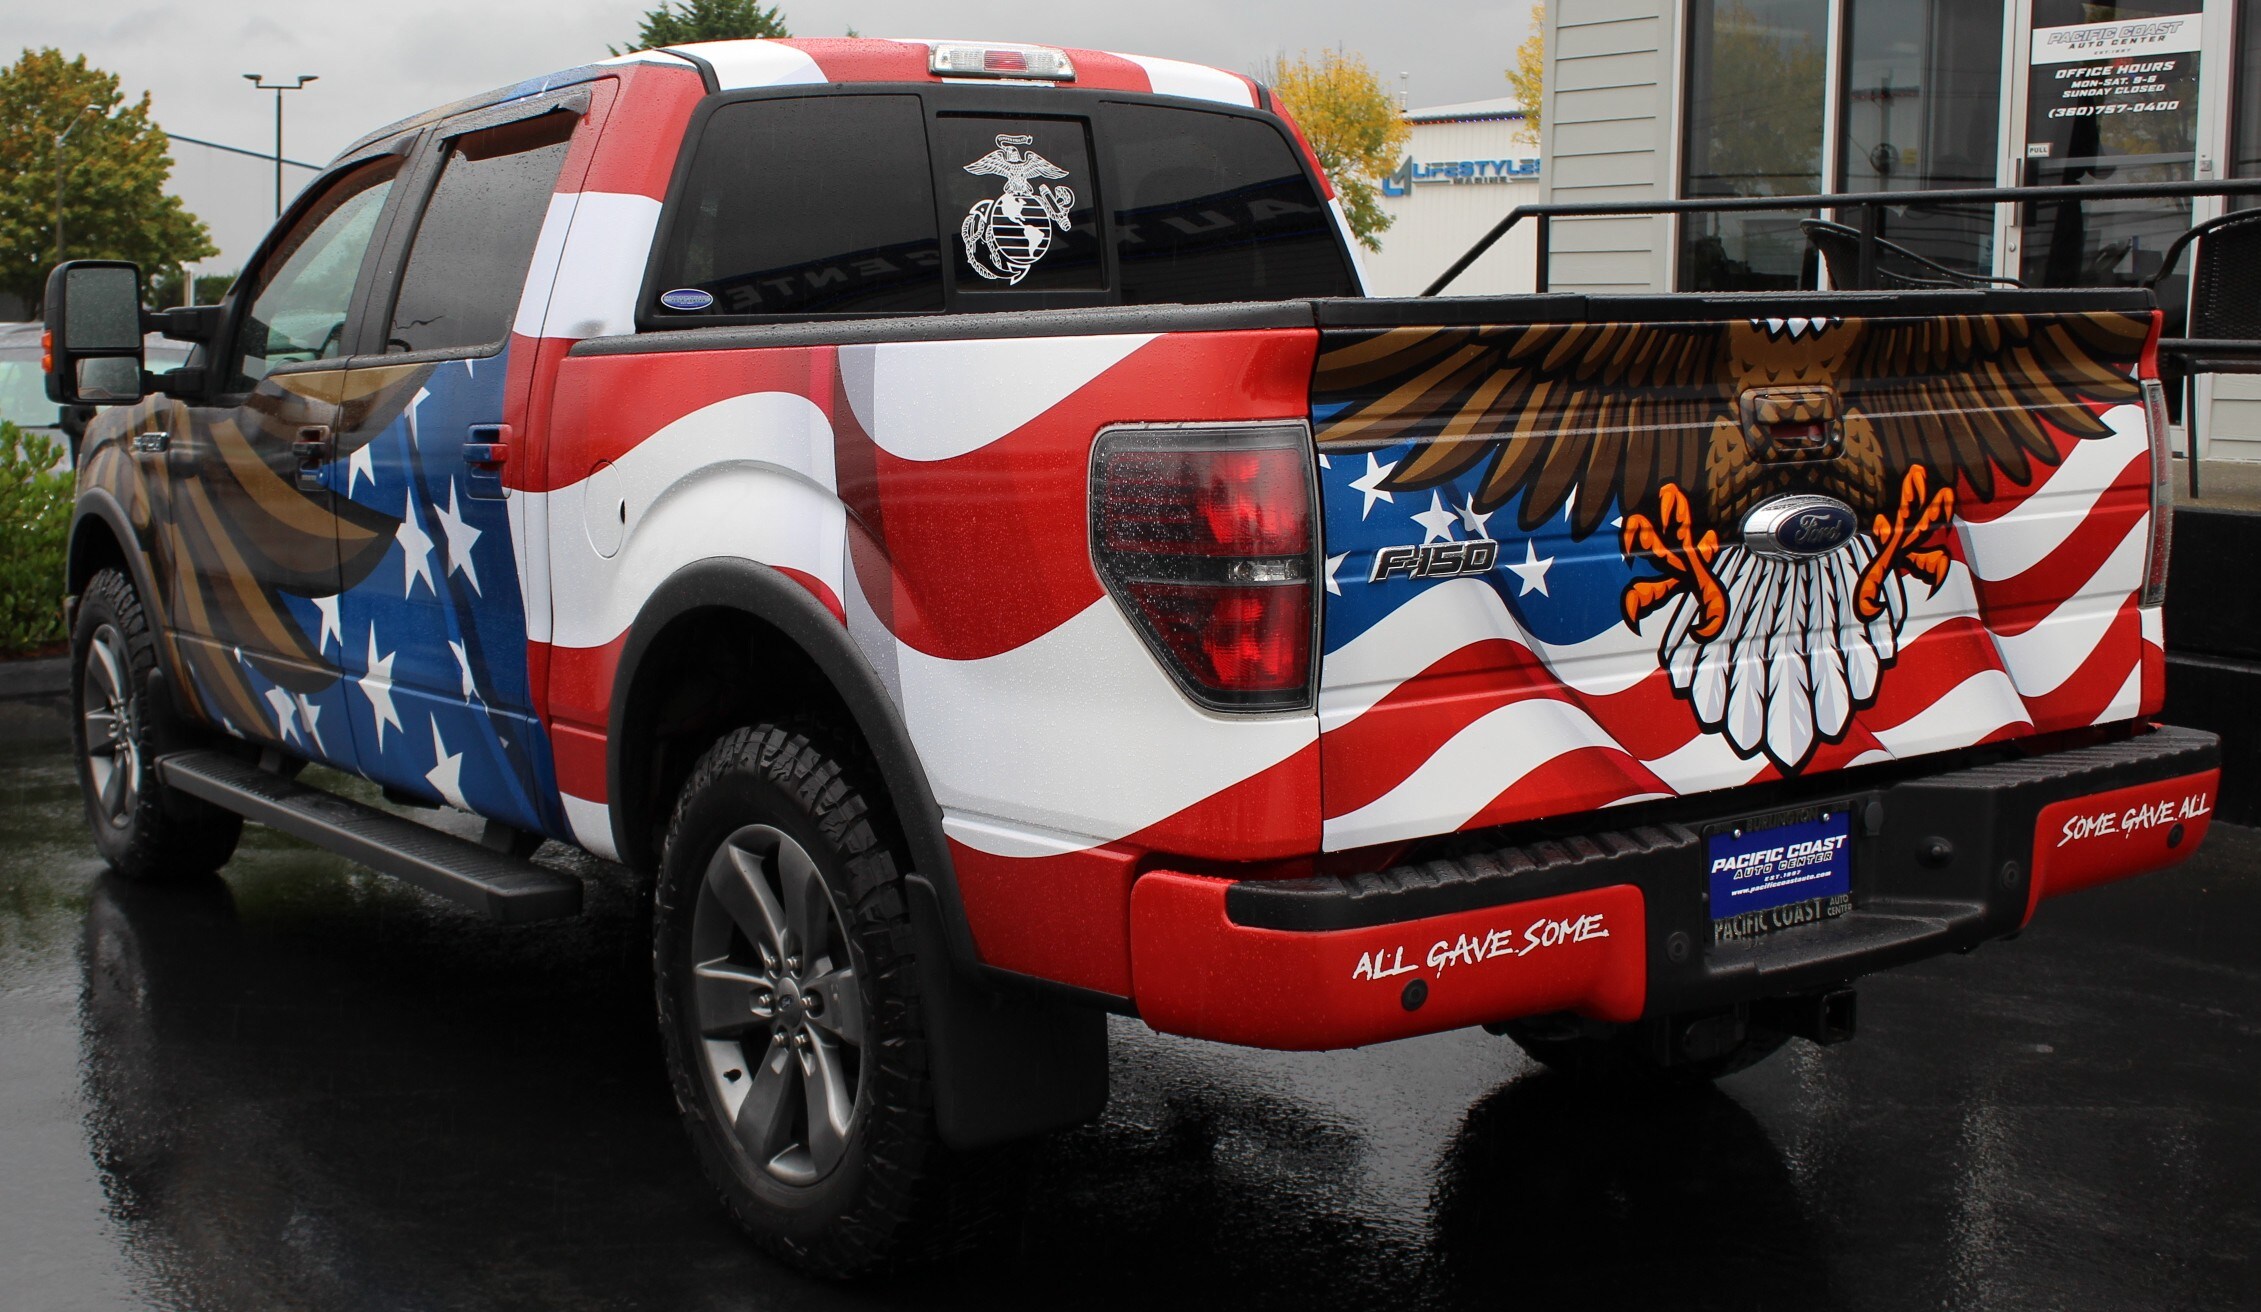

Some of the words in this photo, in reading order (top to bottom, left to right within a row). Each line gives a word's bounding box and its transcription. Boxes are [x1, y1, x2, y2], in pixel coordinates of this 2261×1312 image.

[2047, 27, 2117, 45] PACIFIC
[2119, 21, 2184, 39] COAST
[2068, 40, 2103, 49] AUTO
[2111, 35, 2166, 46] CENTER
[2055, 66, 2114, 79] OFFICE
[2116, 61, 2176, 74] HOURS
[2062, 87, 2112, 98] SUNDAY
[2114, 84, 2166, 95] CLOSED
[2071, 77, 2129, 88] MON-SAT.
[2048, 100, 2180, 118] (360)757-0400
[2029, 146, 2048, 154] PULL
[1794, 513, 1843, 544] Ford
[1368, 539, 1499, 583] F-150
[2178, 792, 2210, 819] ALL
[1711, 847, 1785, 874] PACIFIC
[1786, 834, 1848, 859] COAST
[1733, 863, 1773, 880] AUTO
[1778, 851, 1833, 871] CENTER
[1731, 871, 1832, 896] www.pacificcoastauto.com
[1827, 903, 1853, 917] CENTER
[1829, 895, 1849, 906] AUTO
[1714, 909, 1768, 941] PACIFIC
[1772, 897, 1822, 927] COAST
[1352, 946, 1418, 980] ALL
